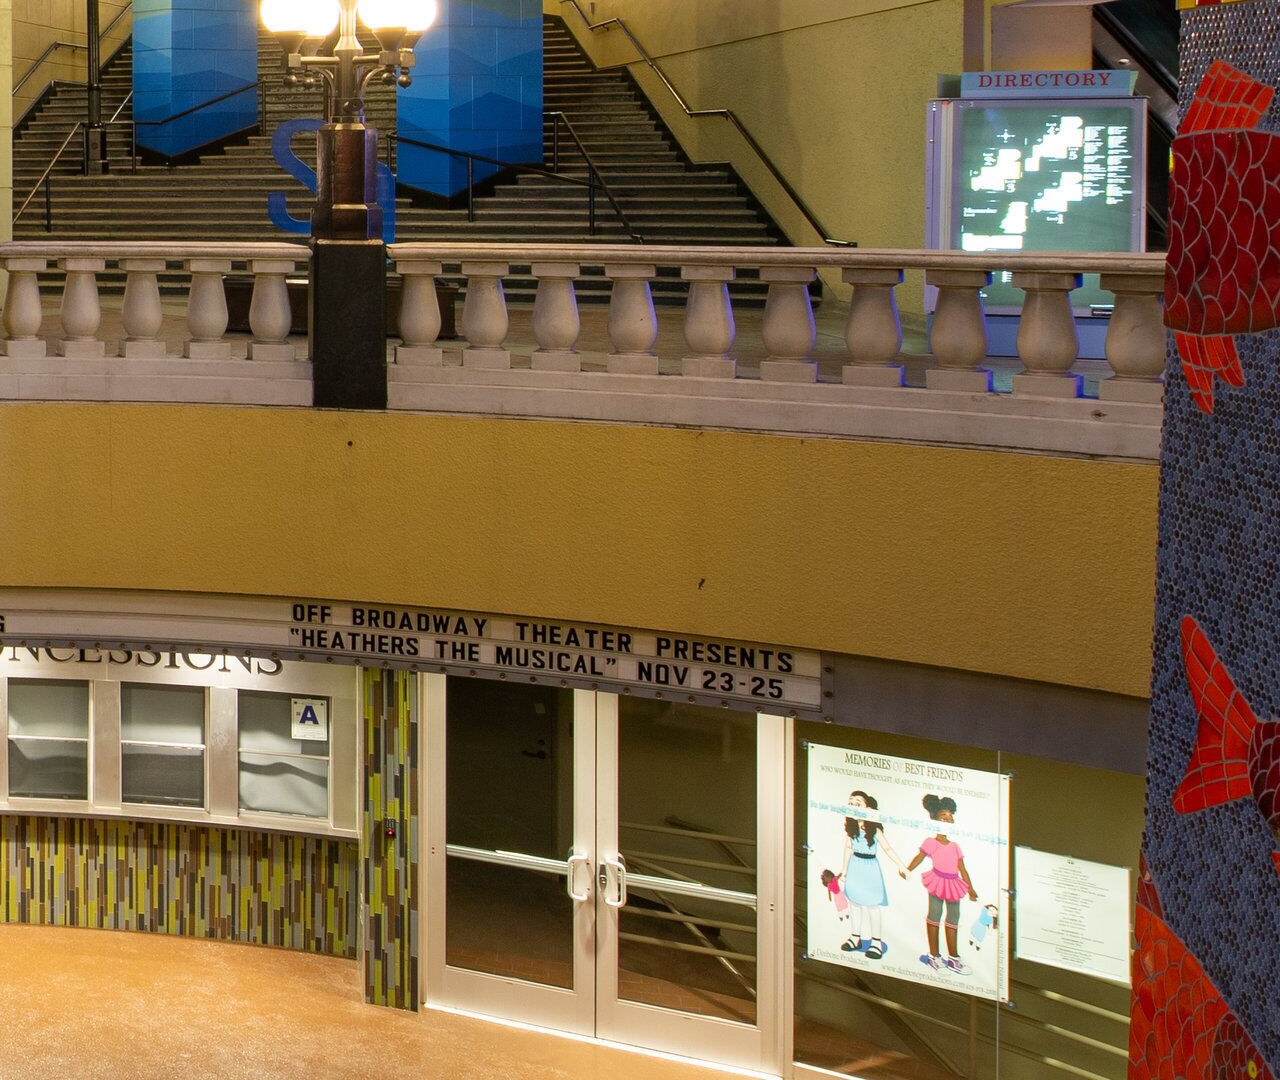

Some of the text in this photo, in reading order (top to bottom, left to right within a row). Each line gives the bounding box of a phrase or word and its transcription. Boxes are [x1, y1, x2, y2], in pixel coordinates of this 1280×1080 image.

[978, 72, 1112, 89] DIRECTORY
[292, 603, 794, 673] OFF BROADWAY THEATER PRESENTS
[289, 627, 784, 700] "HEATHERS THE MUSICAL" NOV 23-25
[299, 704, 320, 725] A
[844, 752, 891, 770] MEMORIES
[904, 762, 926, 777] BEST
[926, 766, 964, 782] FRIENDS
